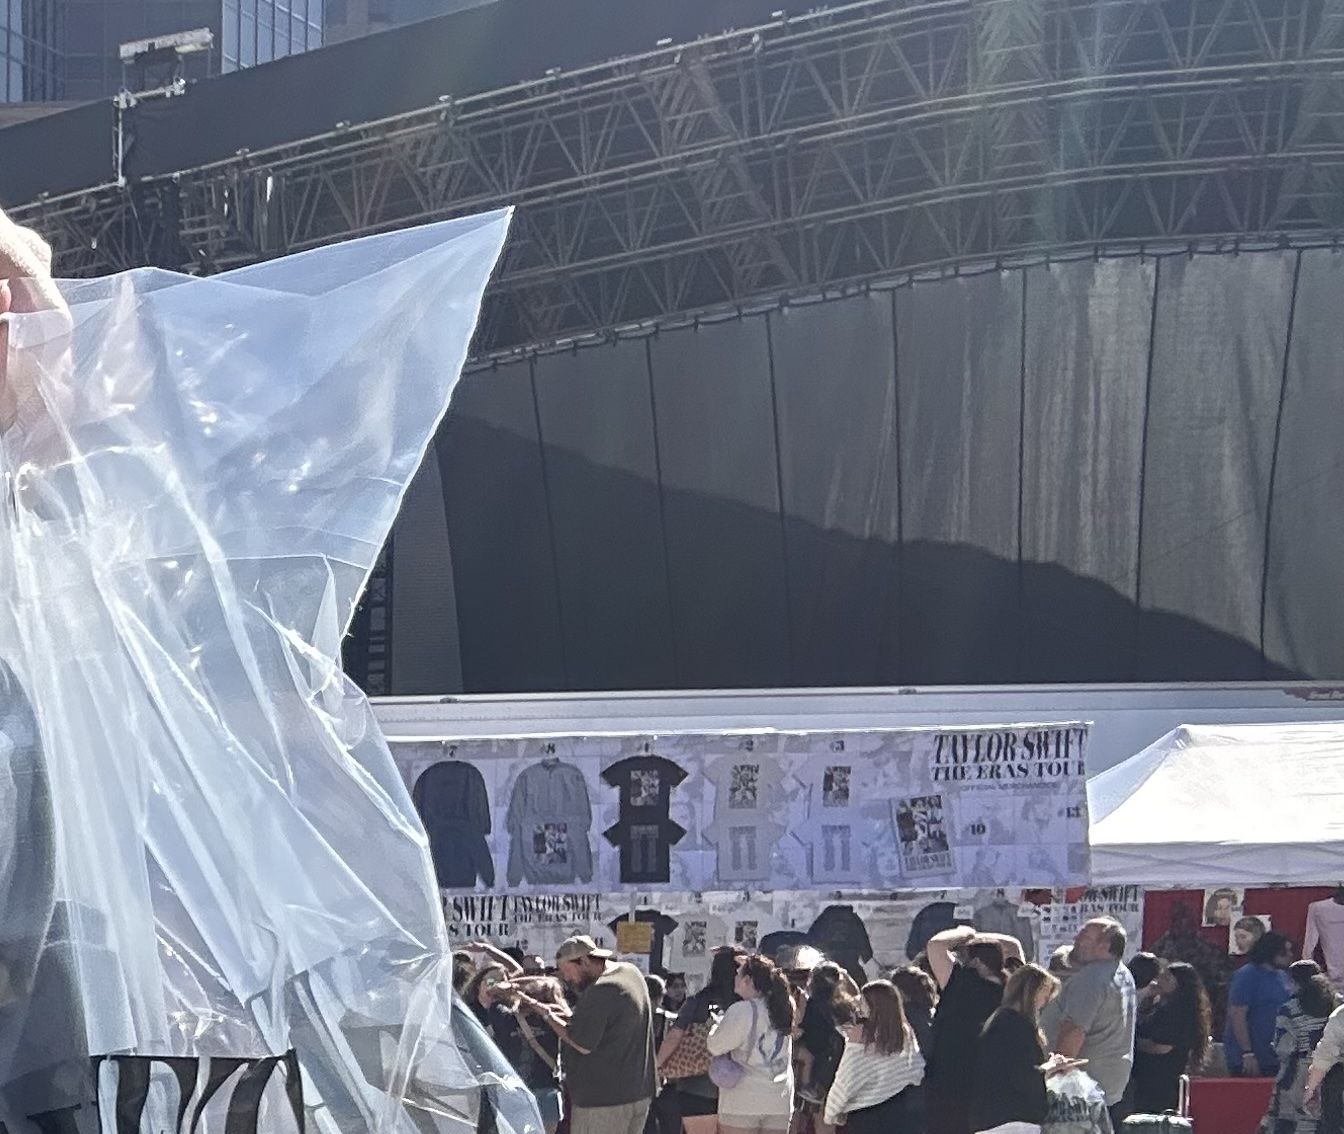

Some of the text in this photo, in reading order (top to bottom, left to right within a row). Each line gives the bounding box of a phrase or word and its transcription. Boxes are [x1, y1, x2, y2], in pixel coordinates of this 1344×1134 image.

[933, 728, 1088, 765] TAYLOR SWIFT
[932, 761, 1086, 782] THE ERAS TOUR
[971, 823, 986, 835] 10
[453, 896, 509, 922] SWIFT
[464, 923, 509, 937] TOUR
